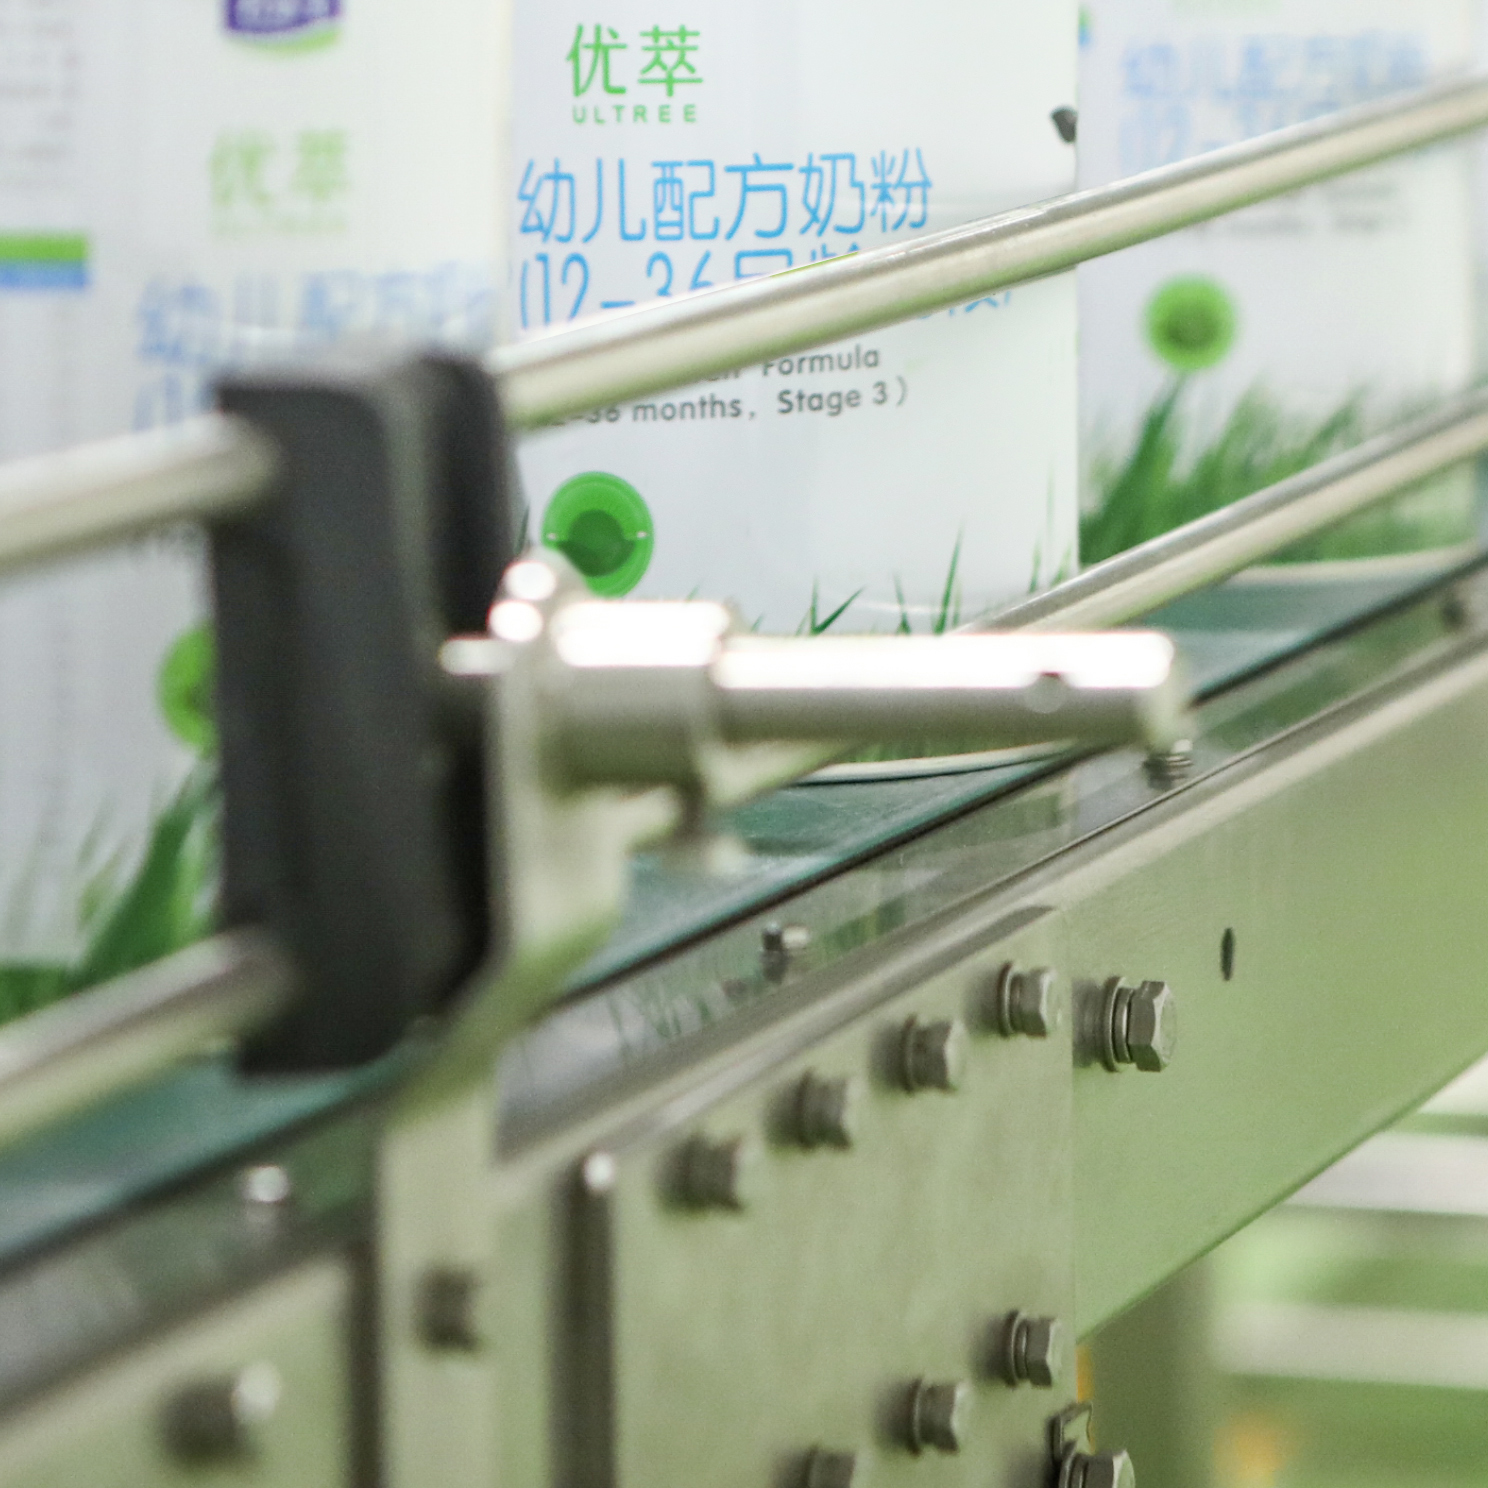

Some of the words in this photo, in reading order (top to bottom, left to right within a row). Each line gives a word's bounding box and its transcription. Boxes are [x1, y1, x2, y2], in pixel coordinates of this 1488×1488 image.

[565, 23, 703, 97] 优萃
[572, 103, 697, 124] ULTREE
[516, 146, 933, 245] 幼儿配方奶粉
[778, 388, 861, 417] Stage
